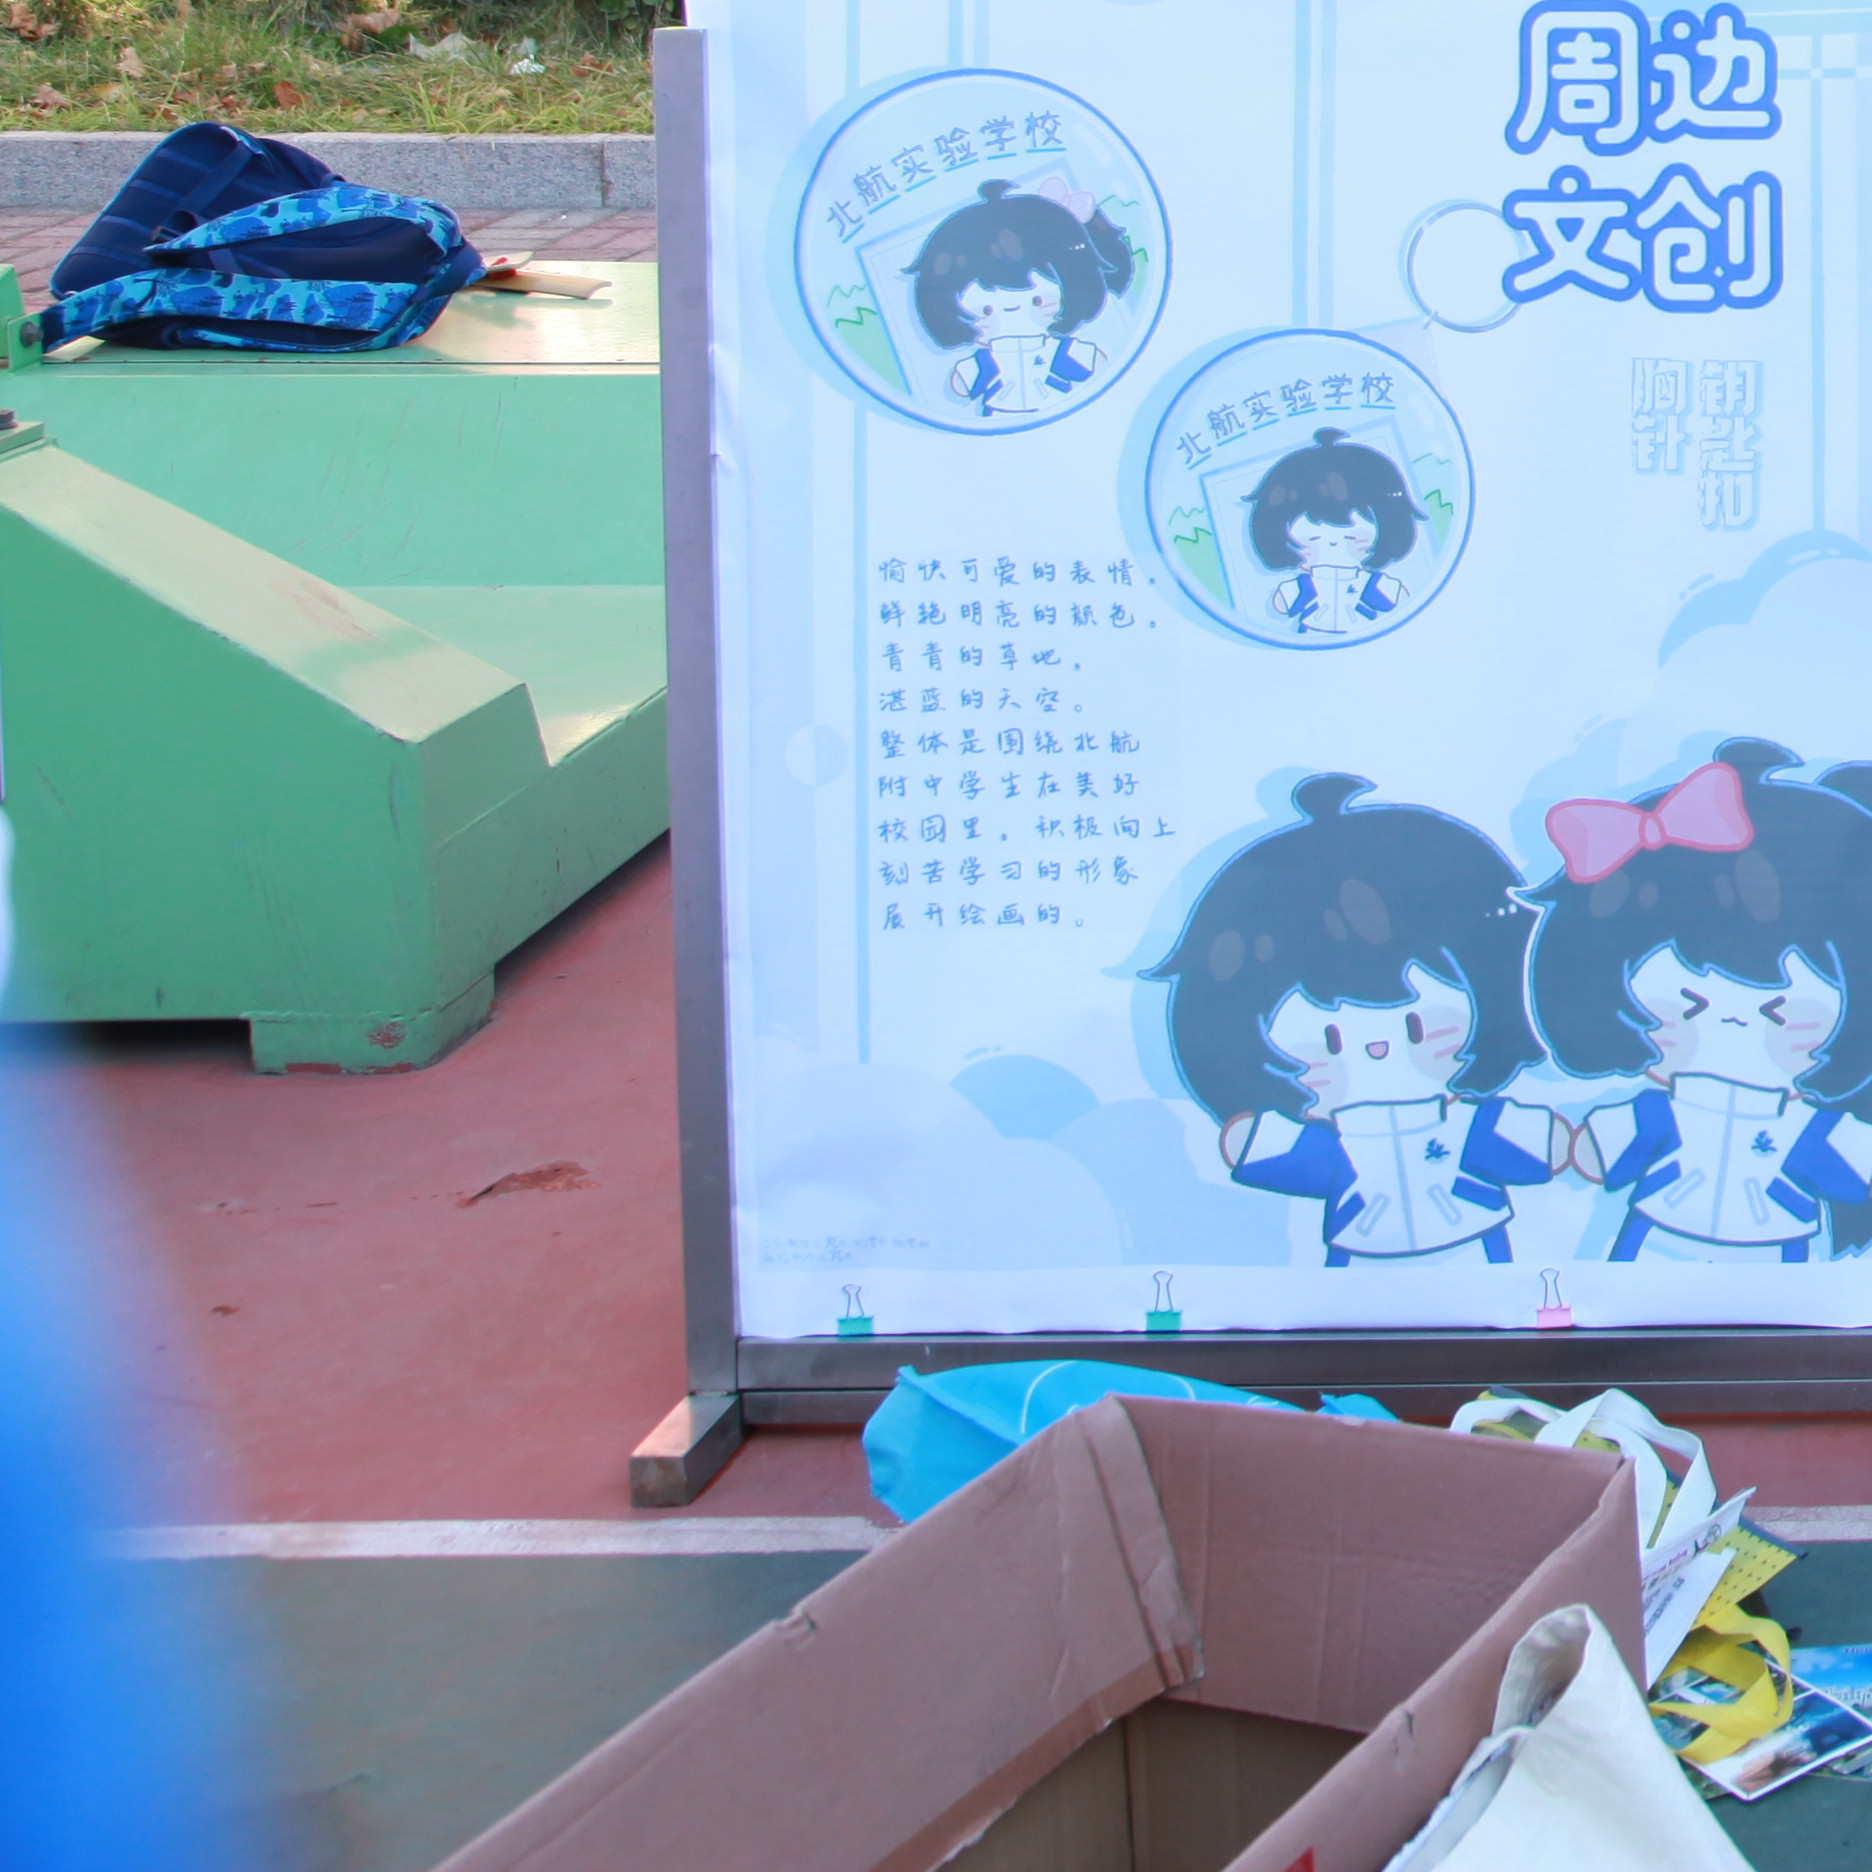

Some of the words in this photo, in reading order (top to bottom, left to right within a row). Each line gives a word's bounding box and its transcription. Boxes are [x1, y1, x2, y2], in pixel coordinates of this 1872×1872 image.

[827, 110, 1065, 237] 北航实验学校
[1502, 163, 1784, 314] 文创
[1176, 371, 1395, 465] 北航实验学校
[1632, 357, 1692, 475] 胸针
[1698, 359, 1763, 531] 钥匙扣
[878, 770, 1140, 800] 附中学生在美好
[880, 727, 1141, 759] 整体是围绕北航
[878, 855, 1140, 886] 刻苦学习的形象
